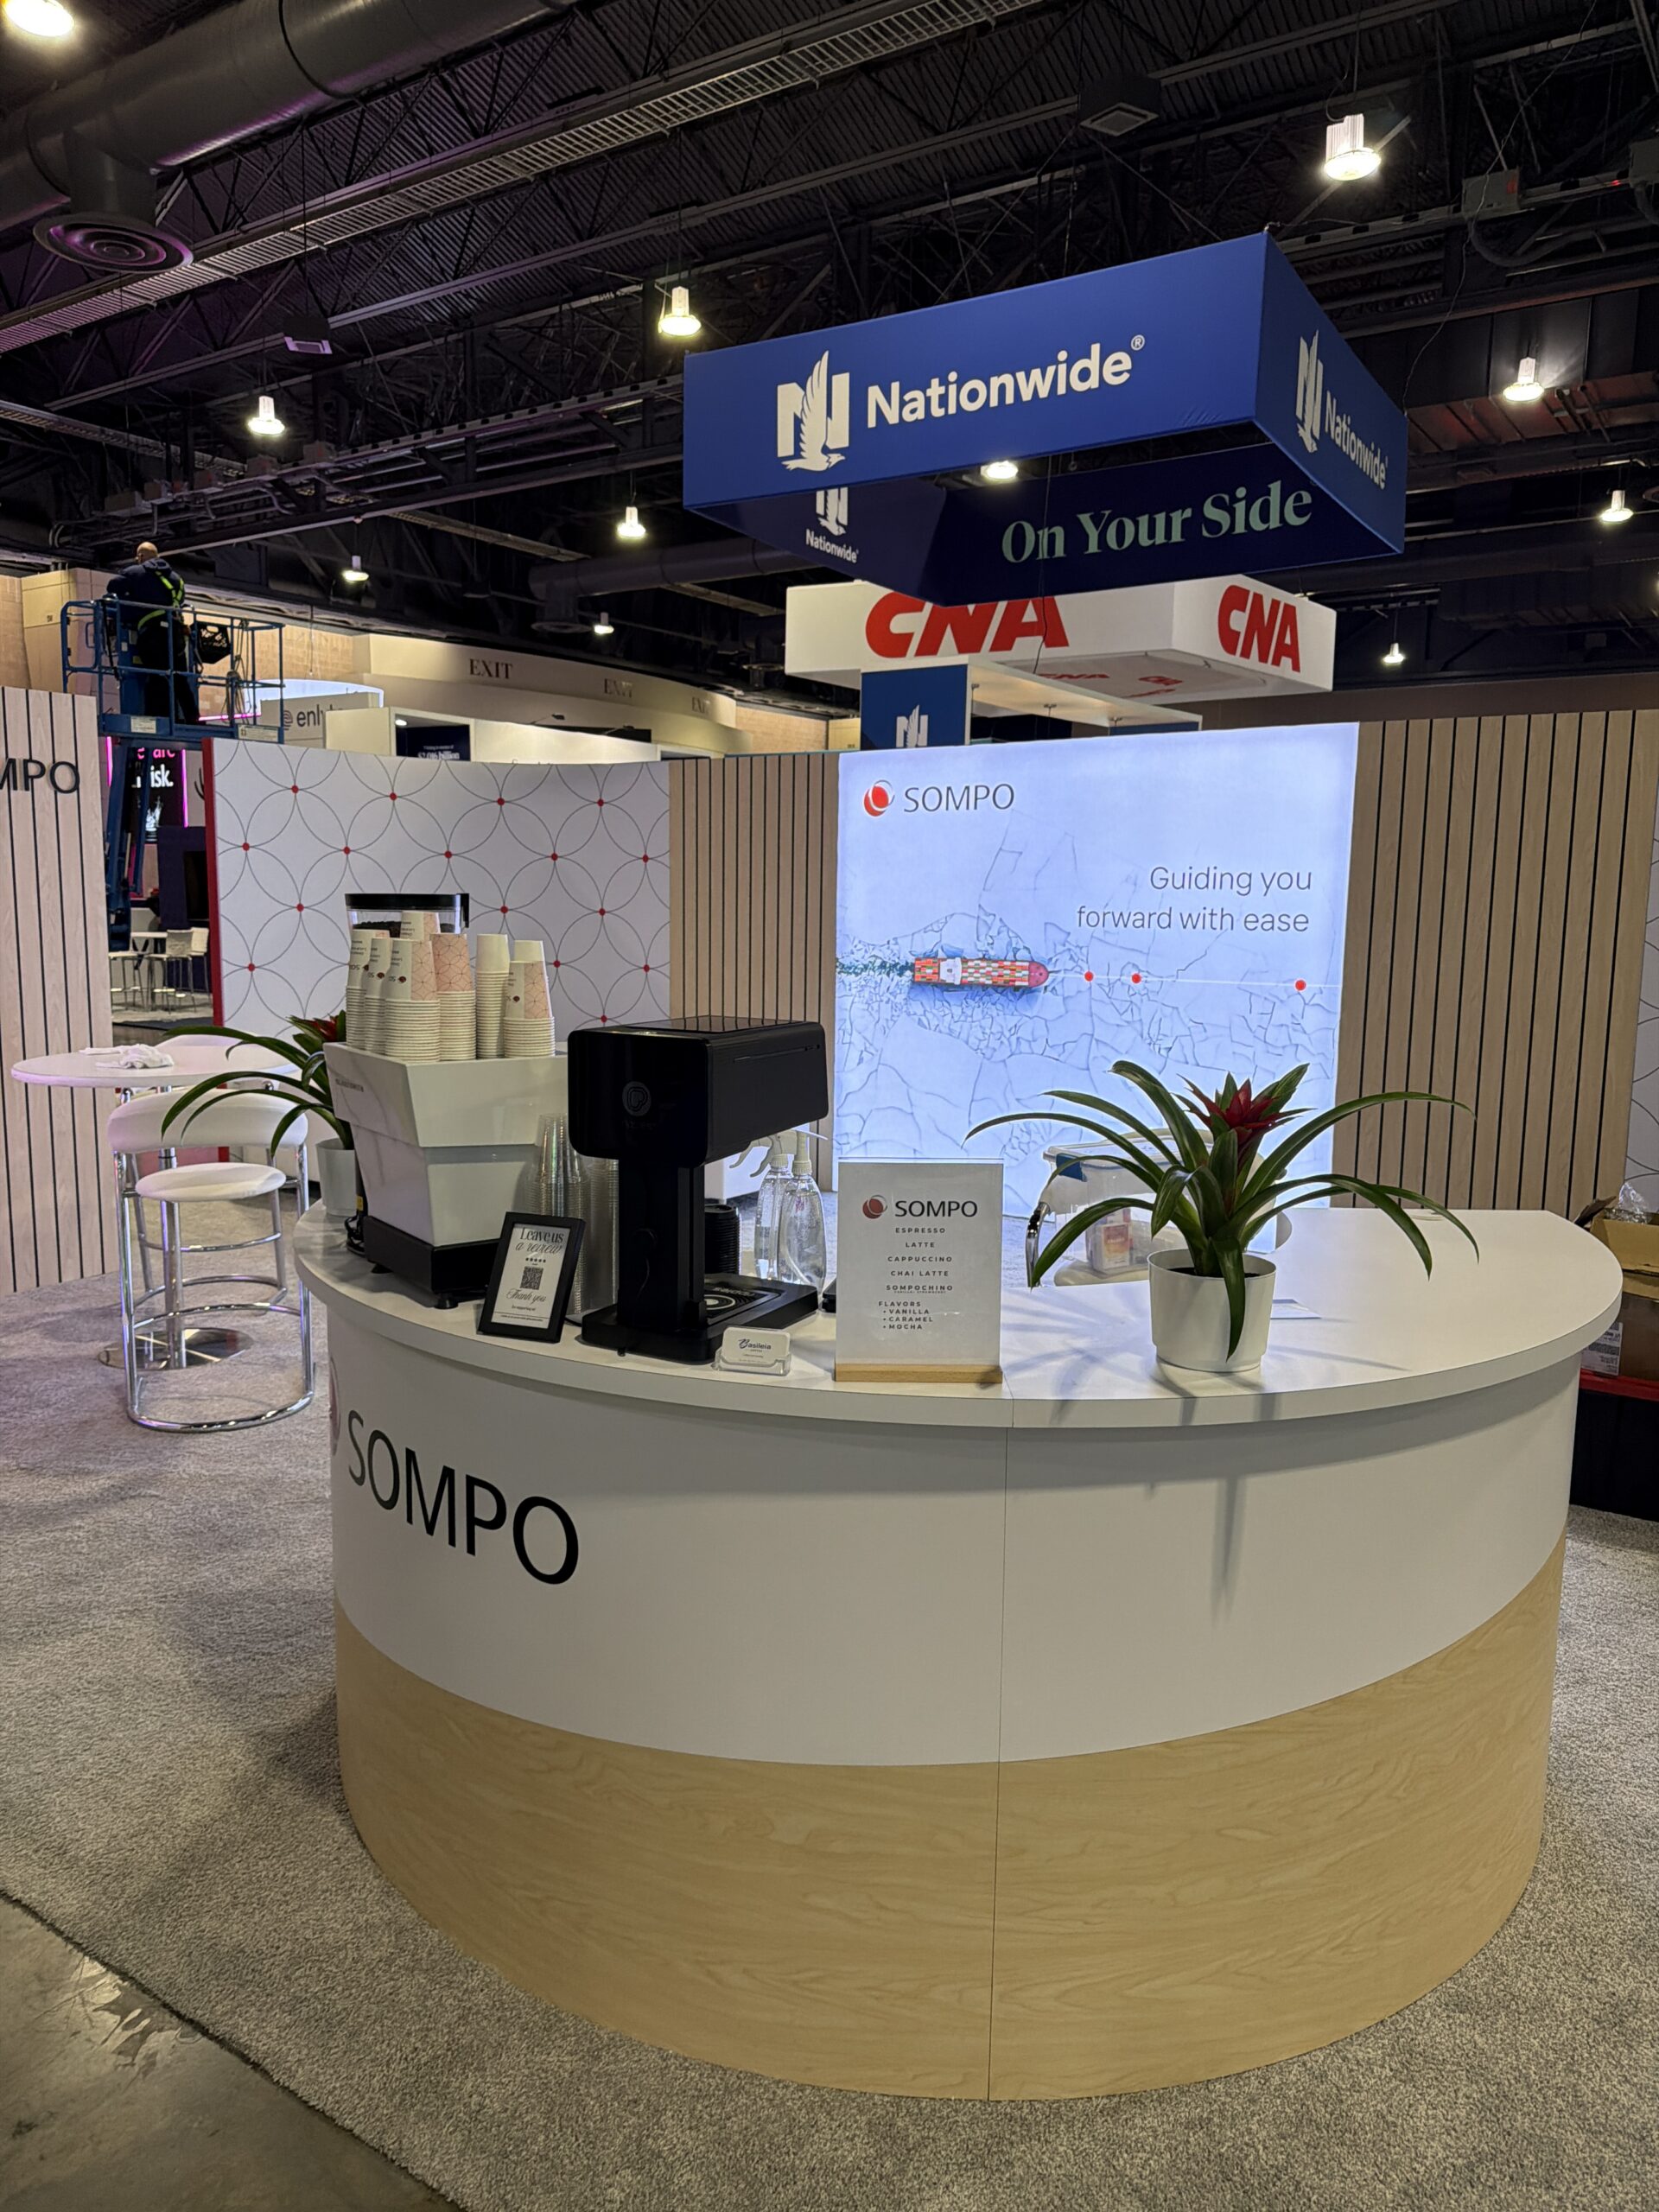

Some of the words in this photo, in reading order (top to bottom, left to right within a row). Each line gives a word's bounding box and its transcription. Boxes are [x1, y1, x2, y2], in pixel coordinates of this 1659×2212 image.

[1325, 391, 1386, 489] Nationwide
[1001, 520, 1067, 563] On
[1077, 510, 1192, 554] Your
[1202, 480, 1313, 537] Side
[806, 529, 857, 563] Nationwide
[865, 591, 1069, 658] CNA
[1218, 584, 1300, 672] CNA
[469, 658, 512, 679] EXIT
[904, 783, 1014, 813] SOMPO
[1150, 866, 1253, 896] Guiding
[1260, 871, 1312, 897] you
[1077, 906, 1173, 929] forward
[1179, 906, 1235, 931] with
[1243, 912, 1310, 932] ease
[894, 1200, 978, 1217] SOMPO
[520, 1227, 550, 1242] Leave
[551, 1232, 565, 1244] us
[505, 1288, 532, 1301] Thank
[348, 1409, 579, 1585] SOMPO
